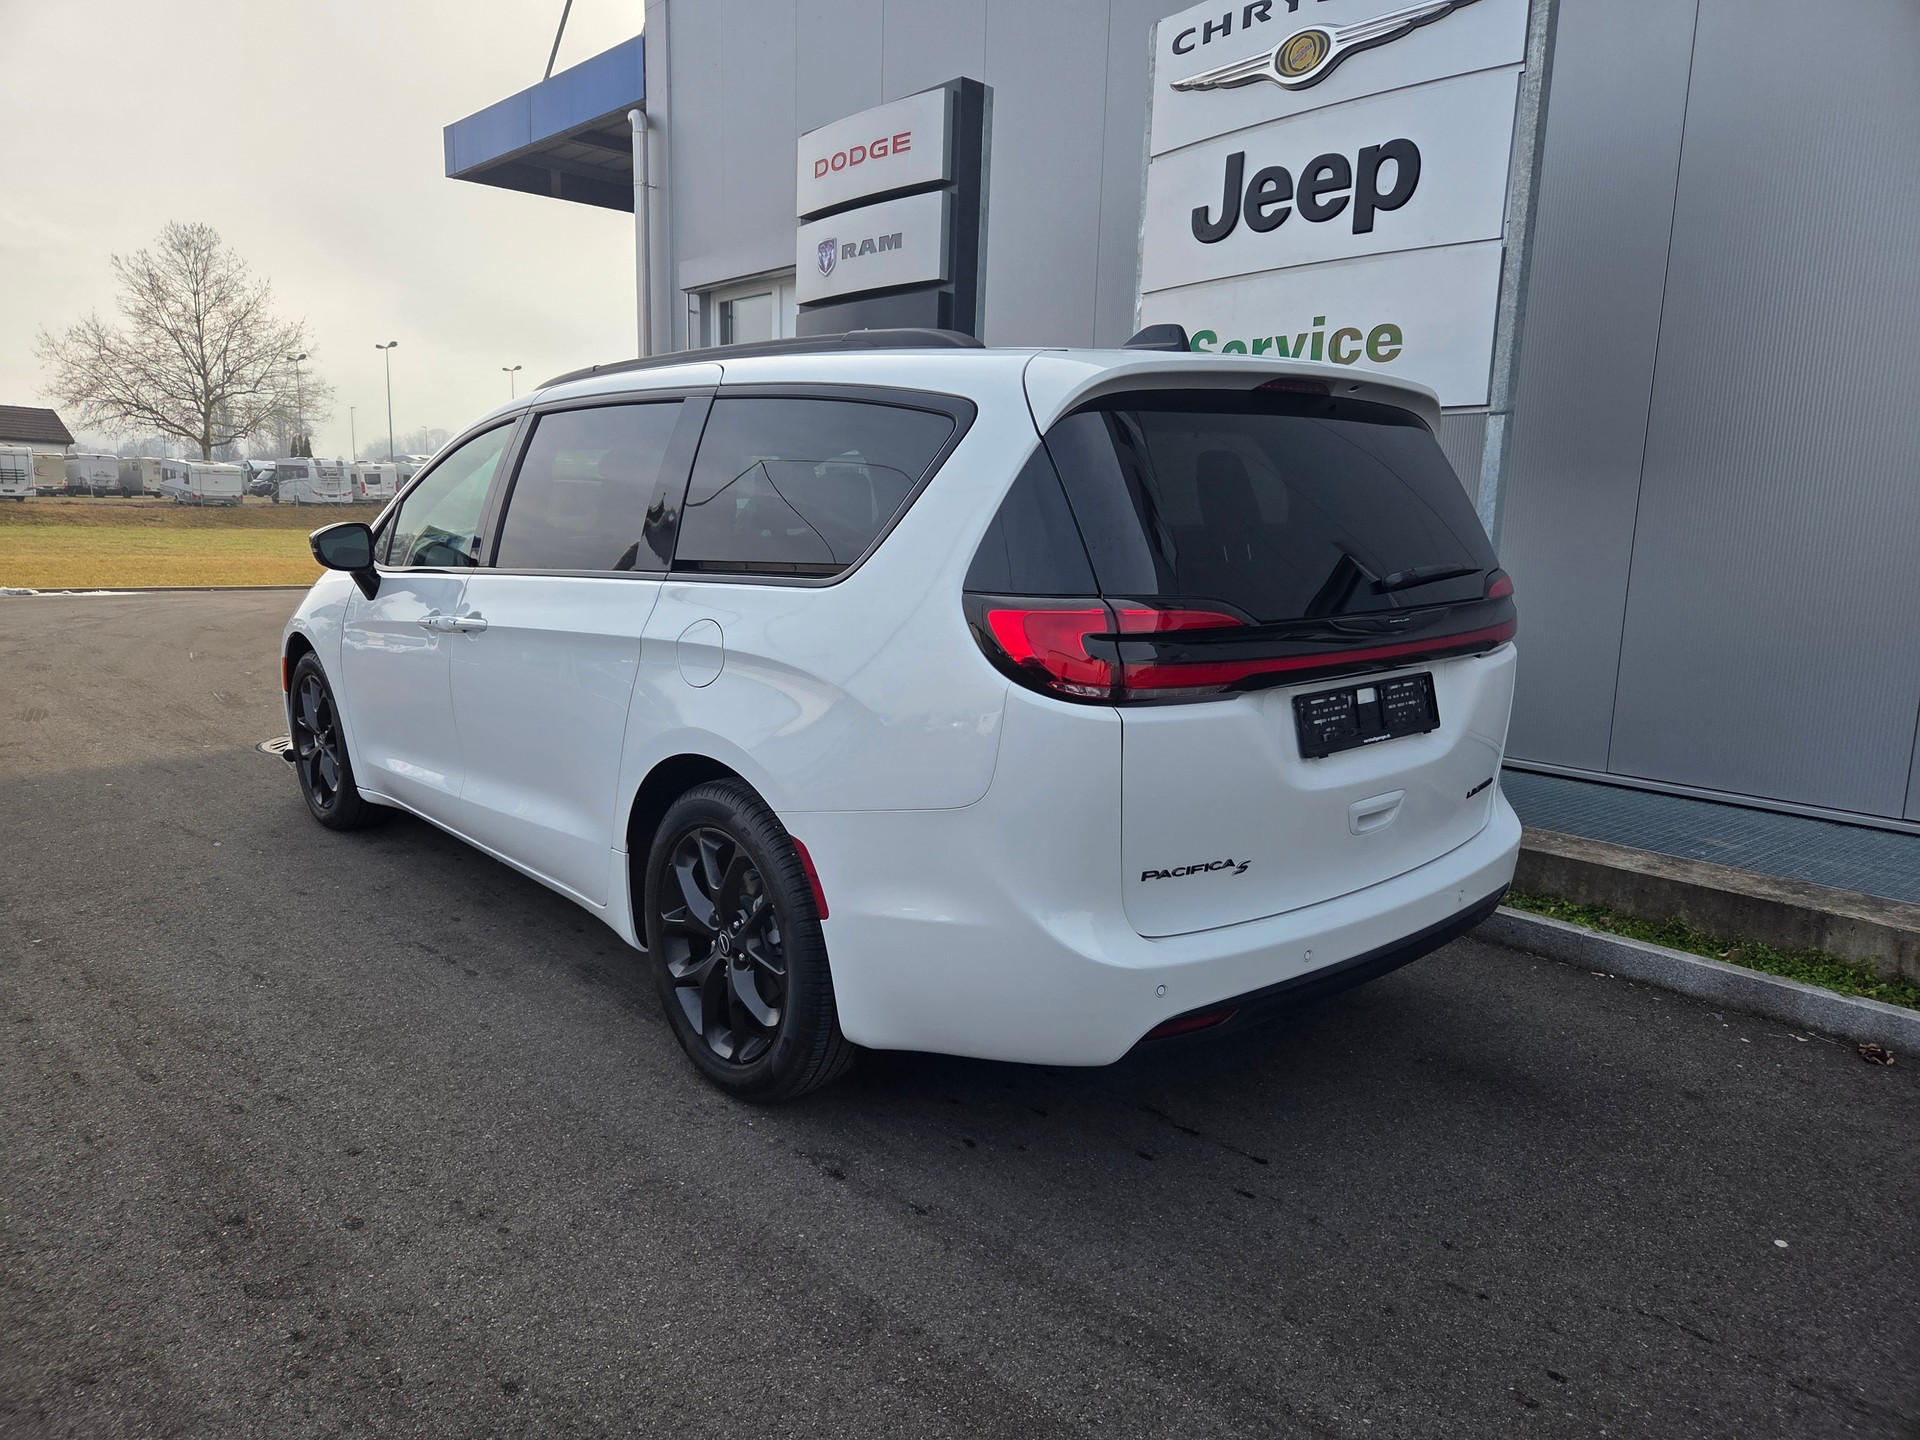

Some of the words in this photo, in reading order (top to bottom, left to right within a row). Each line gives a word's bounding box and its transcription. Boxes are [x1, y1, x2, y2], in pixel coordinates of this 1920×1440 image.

[1172, 0, 1332, 55] CHRY
[814, 131, 912, 179] DODGE
[1191, 137, 1421, 244] Jeep
[841, 232, 903, 260] RAM
[1141, 858, 1236, 882] PACIFICA
